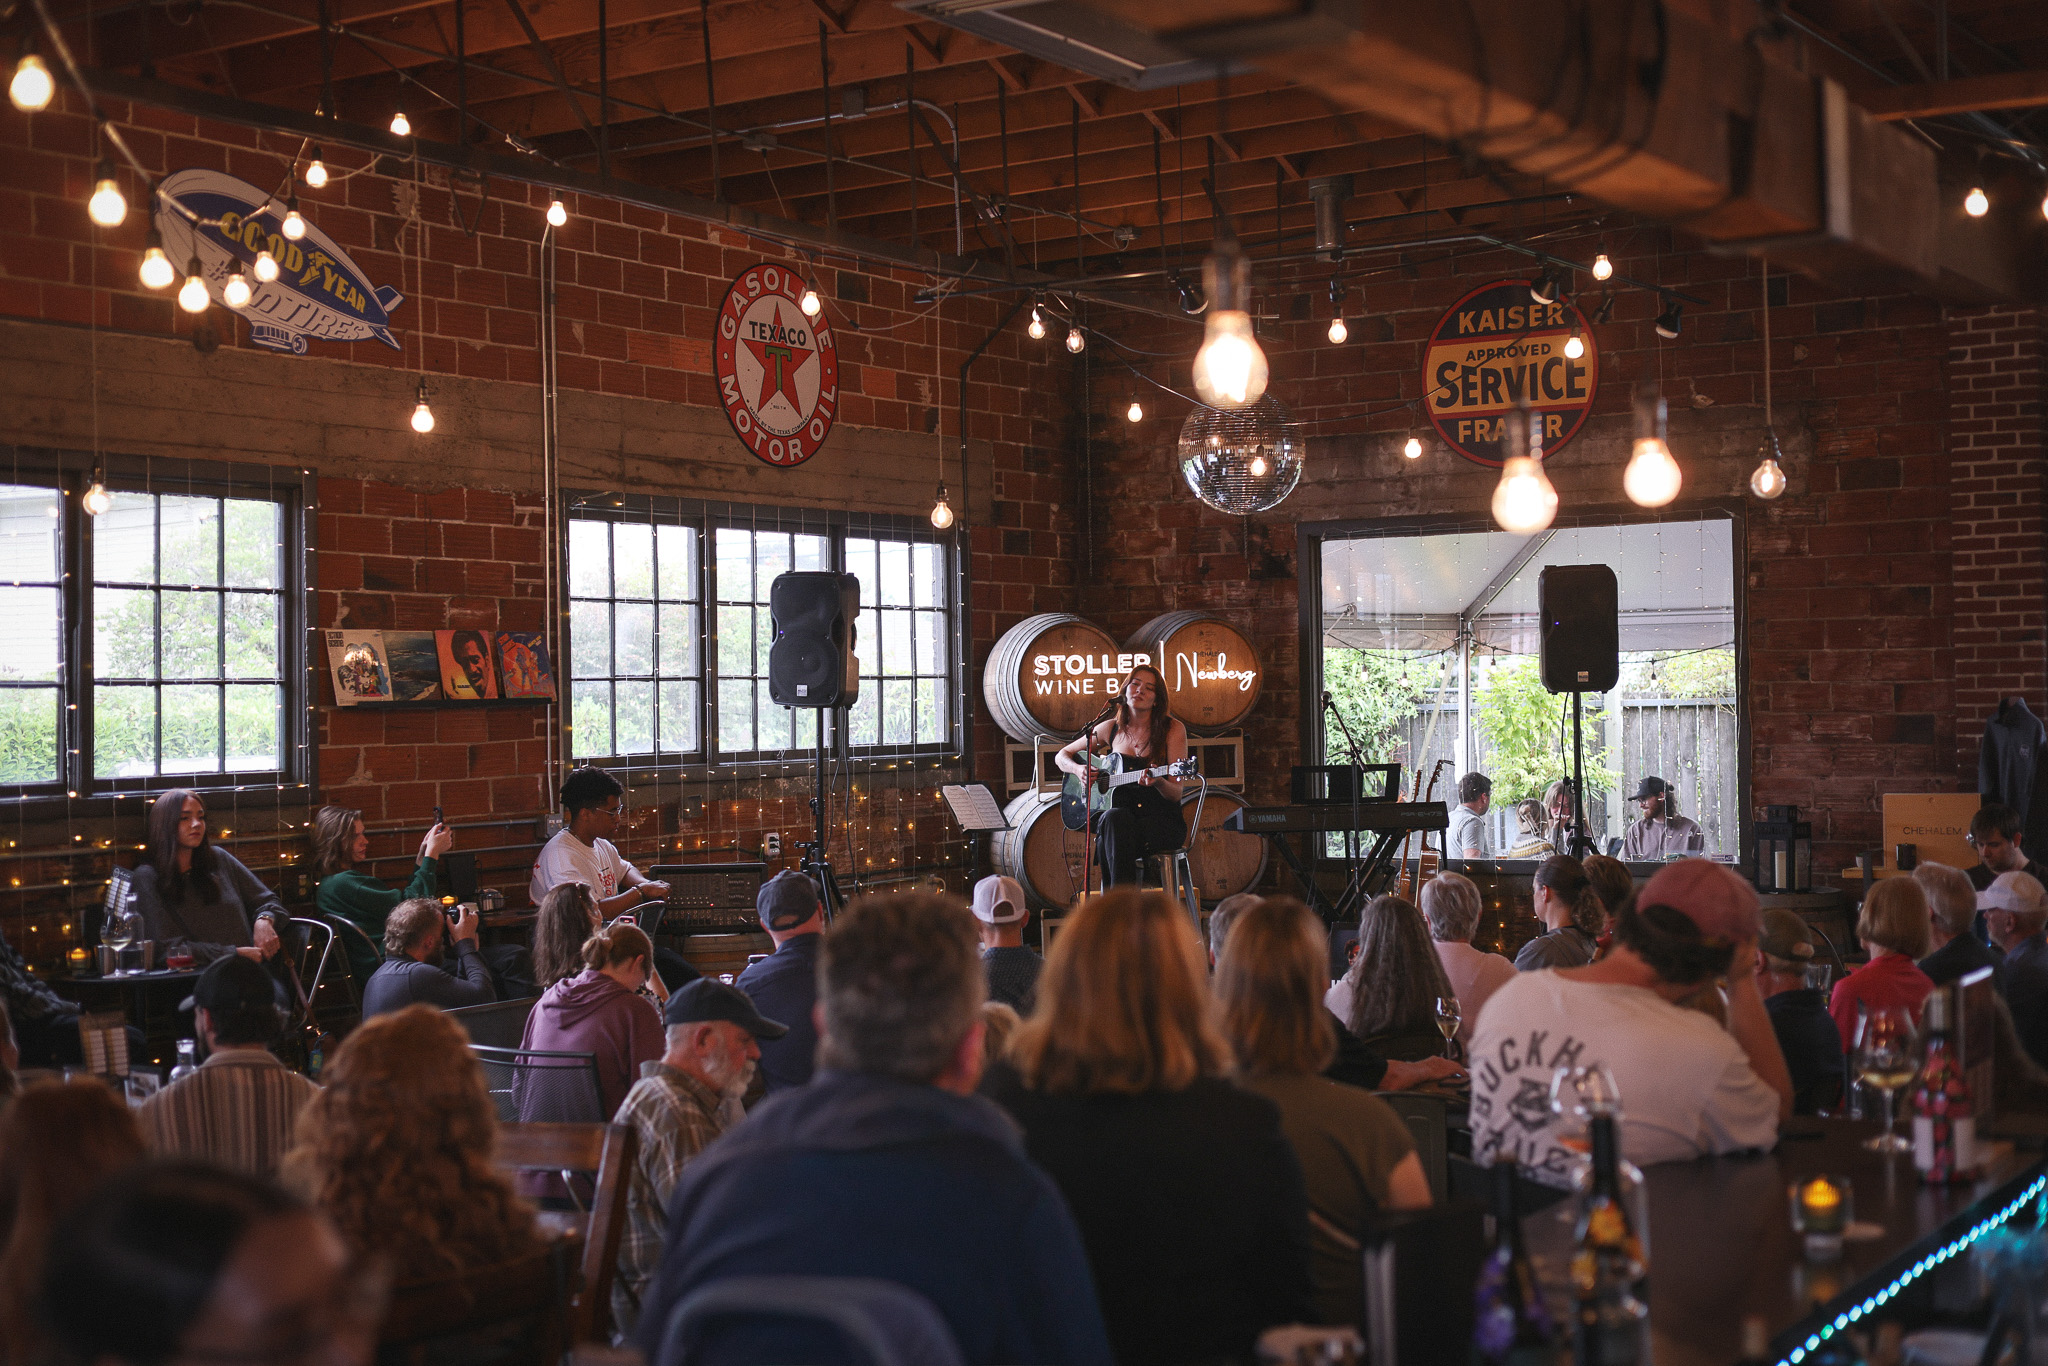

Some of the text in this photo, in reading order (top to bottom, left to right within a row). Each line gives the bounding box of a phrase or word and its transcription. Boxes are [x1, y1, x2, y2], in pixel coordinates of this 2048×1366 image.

[278, 296, 365, 340] TIRES
[1459, 302, 1565, 334] KAISER
[749, 320, 807, 346] TEXACO
[1466, 343, 1551, 362] APPROVED
[1435, 356, 1587, 408] SERVICE
[721, 374, 836, 461] MOTOR OIL
[1035, 678, 1095, 695] WINE
[1176, 652, 1257, 692] Newberg
[1257, 814, 1286, 824] YAMAHA
[1903, 826, 1962, 835] CHEHALEM
